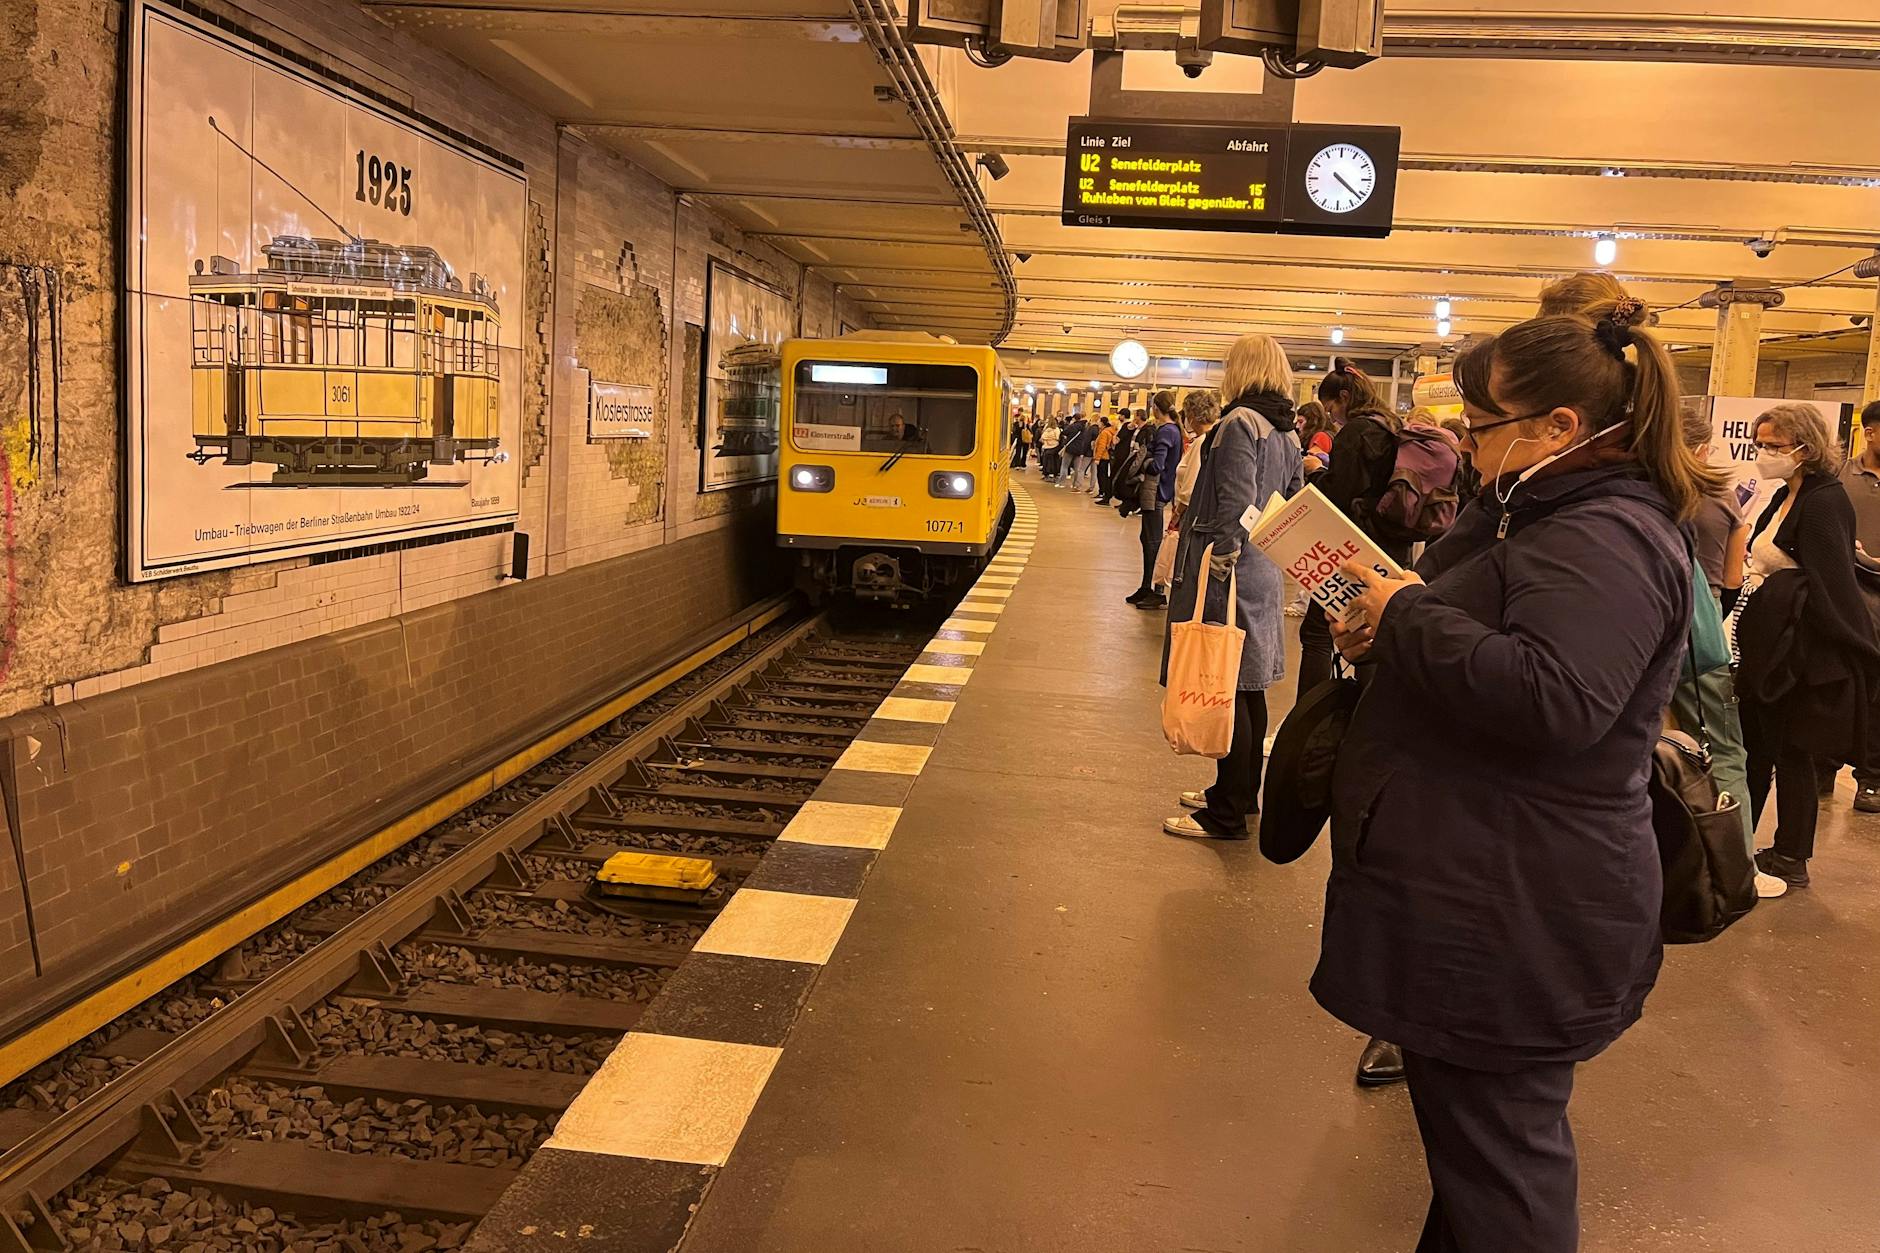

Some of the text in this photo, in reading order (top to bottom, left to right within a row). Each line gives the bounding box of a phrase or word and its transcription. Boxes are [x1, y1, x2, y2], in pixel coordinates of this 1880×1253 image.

[1080, 136, 1269, 152] Linie Ziel Abfahrt
[1080, 153, 1202, 173] U2 Senefelderplatz
[356, 150, 412, 217] 1925
[1079, 178, 1094, 190] U2
[1109, 179, 1200, 195] Senefelderplatz
[1081, 191, 1133, 206] Ruhleben
[1135, 196, 1158, 206] vom
[1159, 194, 1186, 207] Gleis
[1078, 215, 1111, 224] Gleis 1
[332, 385, 351, 403] 3061
[596, 394, 653, 422] Klosterstrasse
[286, 519, 298, 530] der
[300, 516, 330, 529] Berliner
[331, 511, 373, 525] Straßenbahn
[375, 508, 397, 519] Umbau
[926, 520, 964, 533] 1077-1
[1257, 536, 1272, 548] THE
[1270, 504, 1309, 539] MINIMALISTS
[1299, 540, 1361, 591] PEOPLE
[1312, 573, 1348, 601] USE
[1325, 564, 1389, 613] THINS
